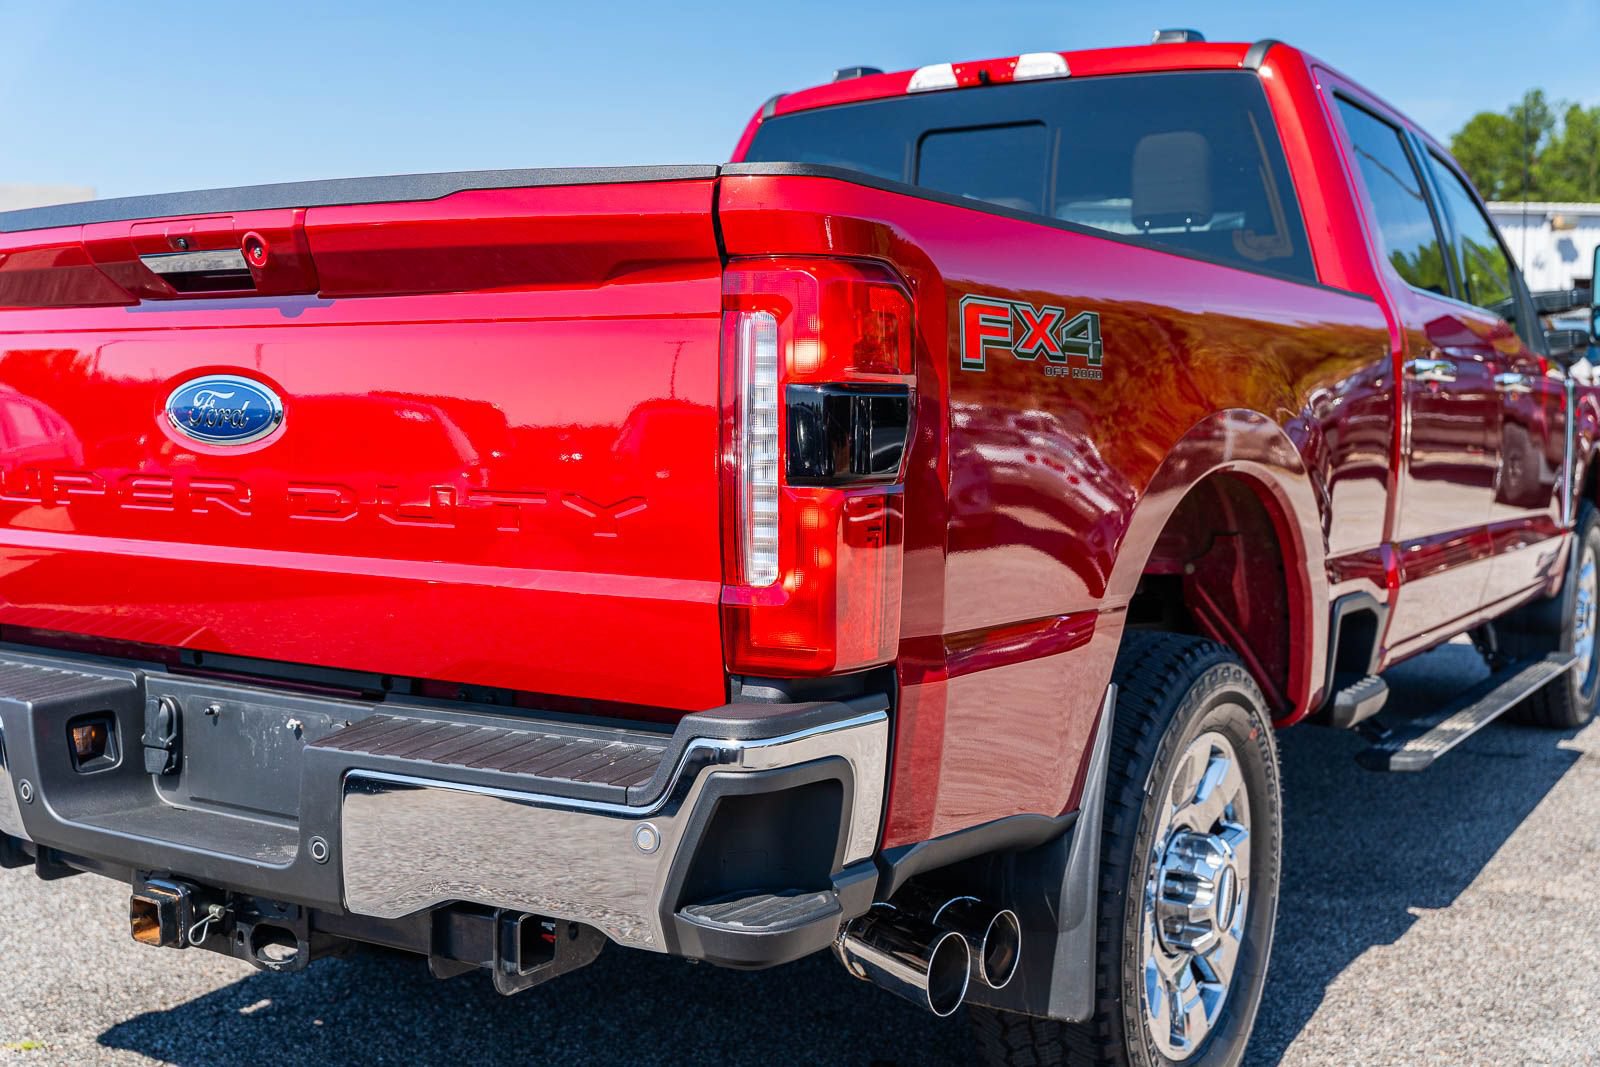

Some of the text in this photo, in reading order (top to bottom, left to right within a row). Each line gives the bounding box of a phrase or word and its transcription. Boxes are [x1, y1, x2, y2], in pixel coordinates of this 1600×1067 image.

[959, 293, 1103, 372] FX4
[1044, 365, 1103, 380] OFF ROAD
[189, 389, 250, 428] Ford
[287, 477, 648, 537] DUTY
